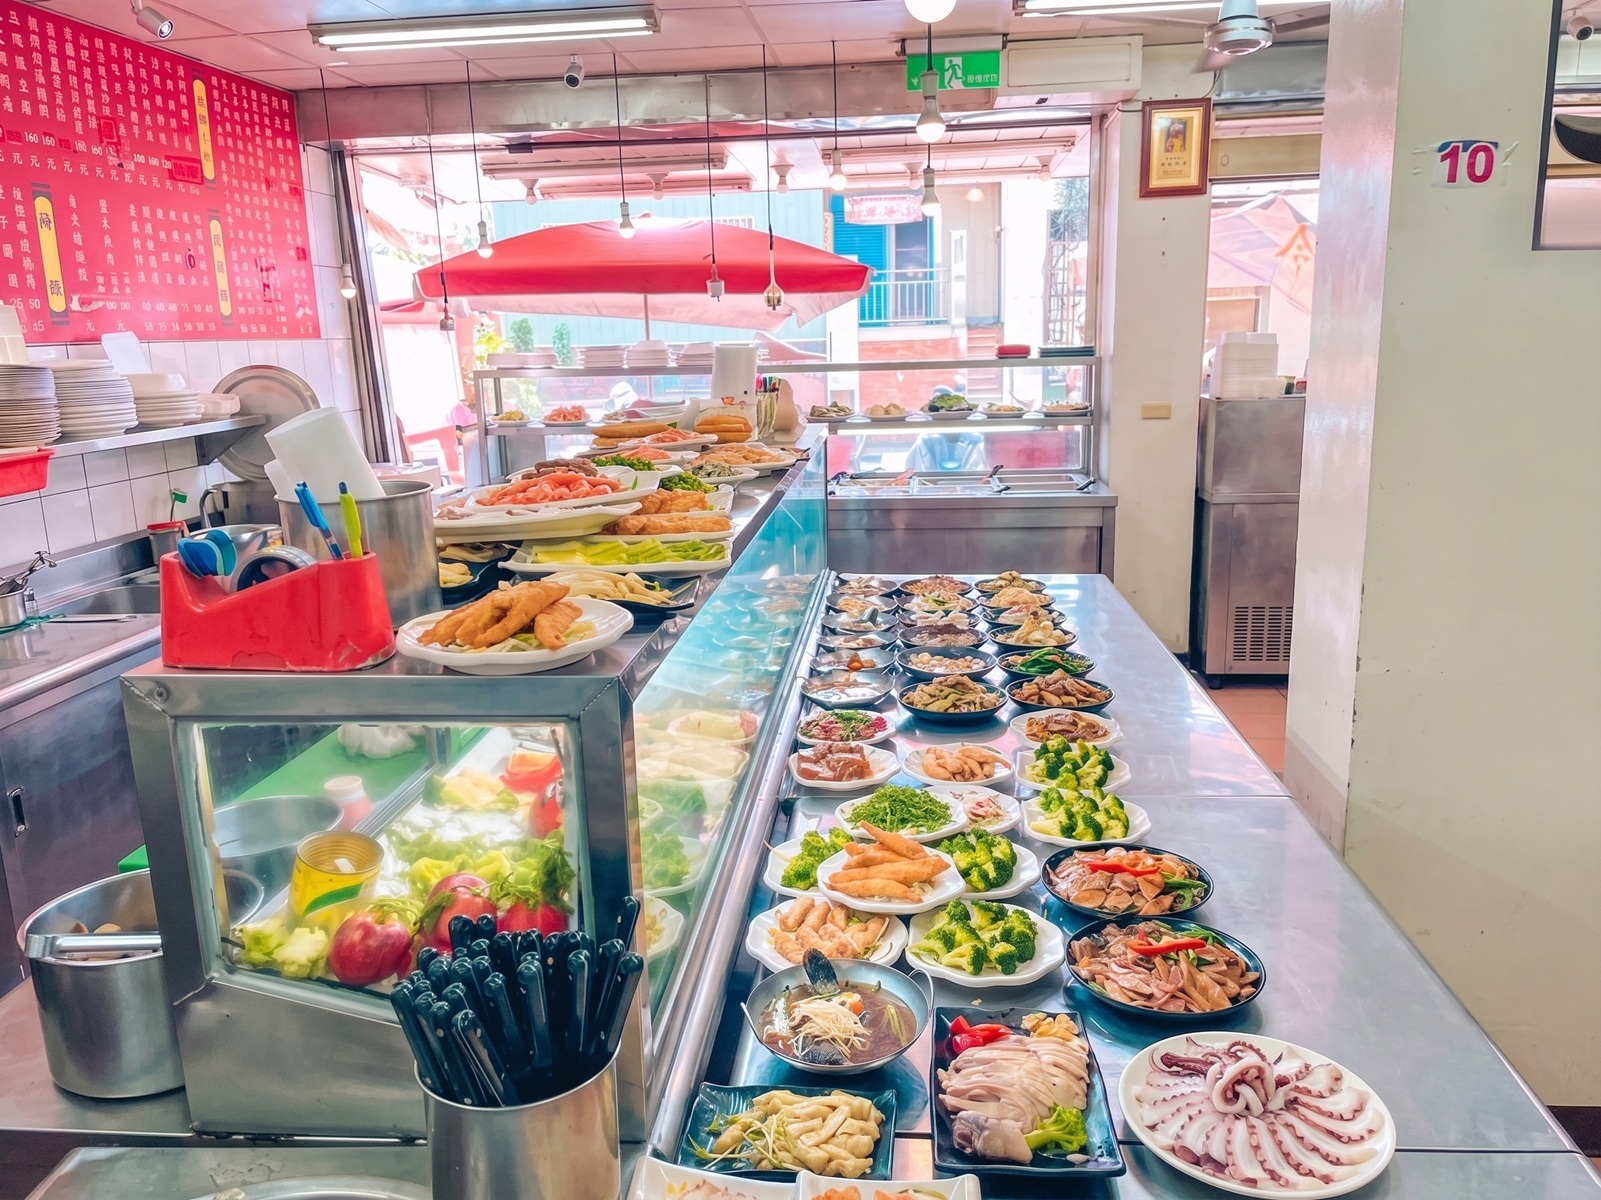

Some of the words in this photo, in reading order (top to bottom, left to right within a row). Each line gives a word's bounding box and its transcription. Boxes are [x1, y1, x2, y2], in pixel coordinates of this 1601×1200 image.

[24, 131, 39, 144] 160
[41, 134, 56, 147] 160
[1440, 144, 1495, 184] 10
[12, 152, 23, 165] 元
[30, 155, 41, 168] 元
[46, 158, 57, 171] 元
[63, 160, 73, 173] 元
[80, 163, 89, 176] 元
[95, 166, 105, 179] 元
[110, 169, 119, 181] 元
[138, 174, 147, 186] 元
[152, 176, 161, 188] 元
[165, 179, 173, 191] 元
[177, 181, 186, 193] 元
[28, 298, 41, 310] 50
[86, 319, 95, 332] 元
